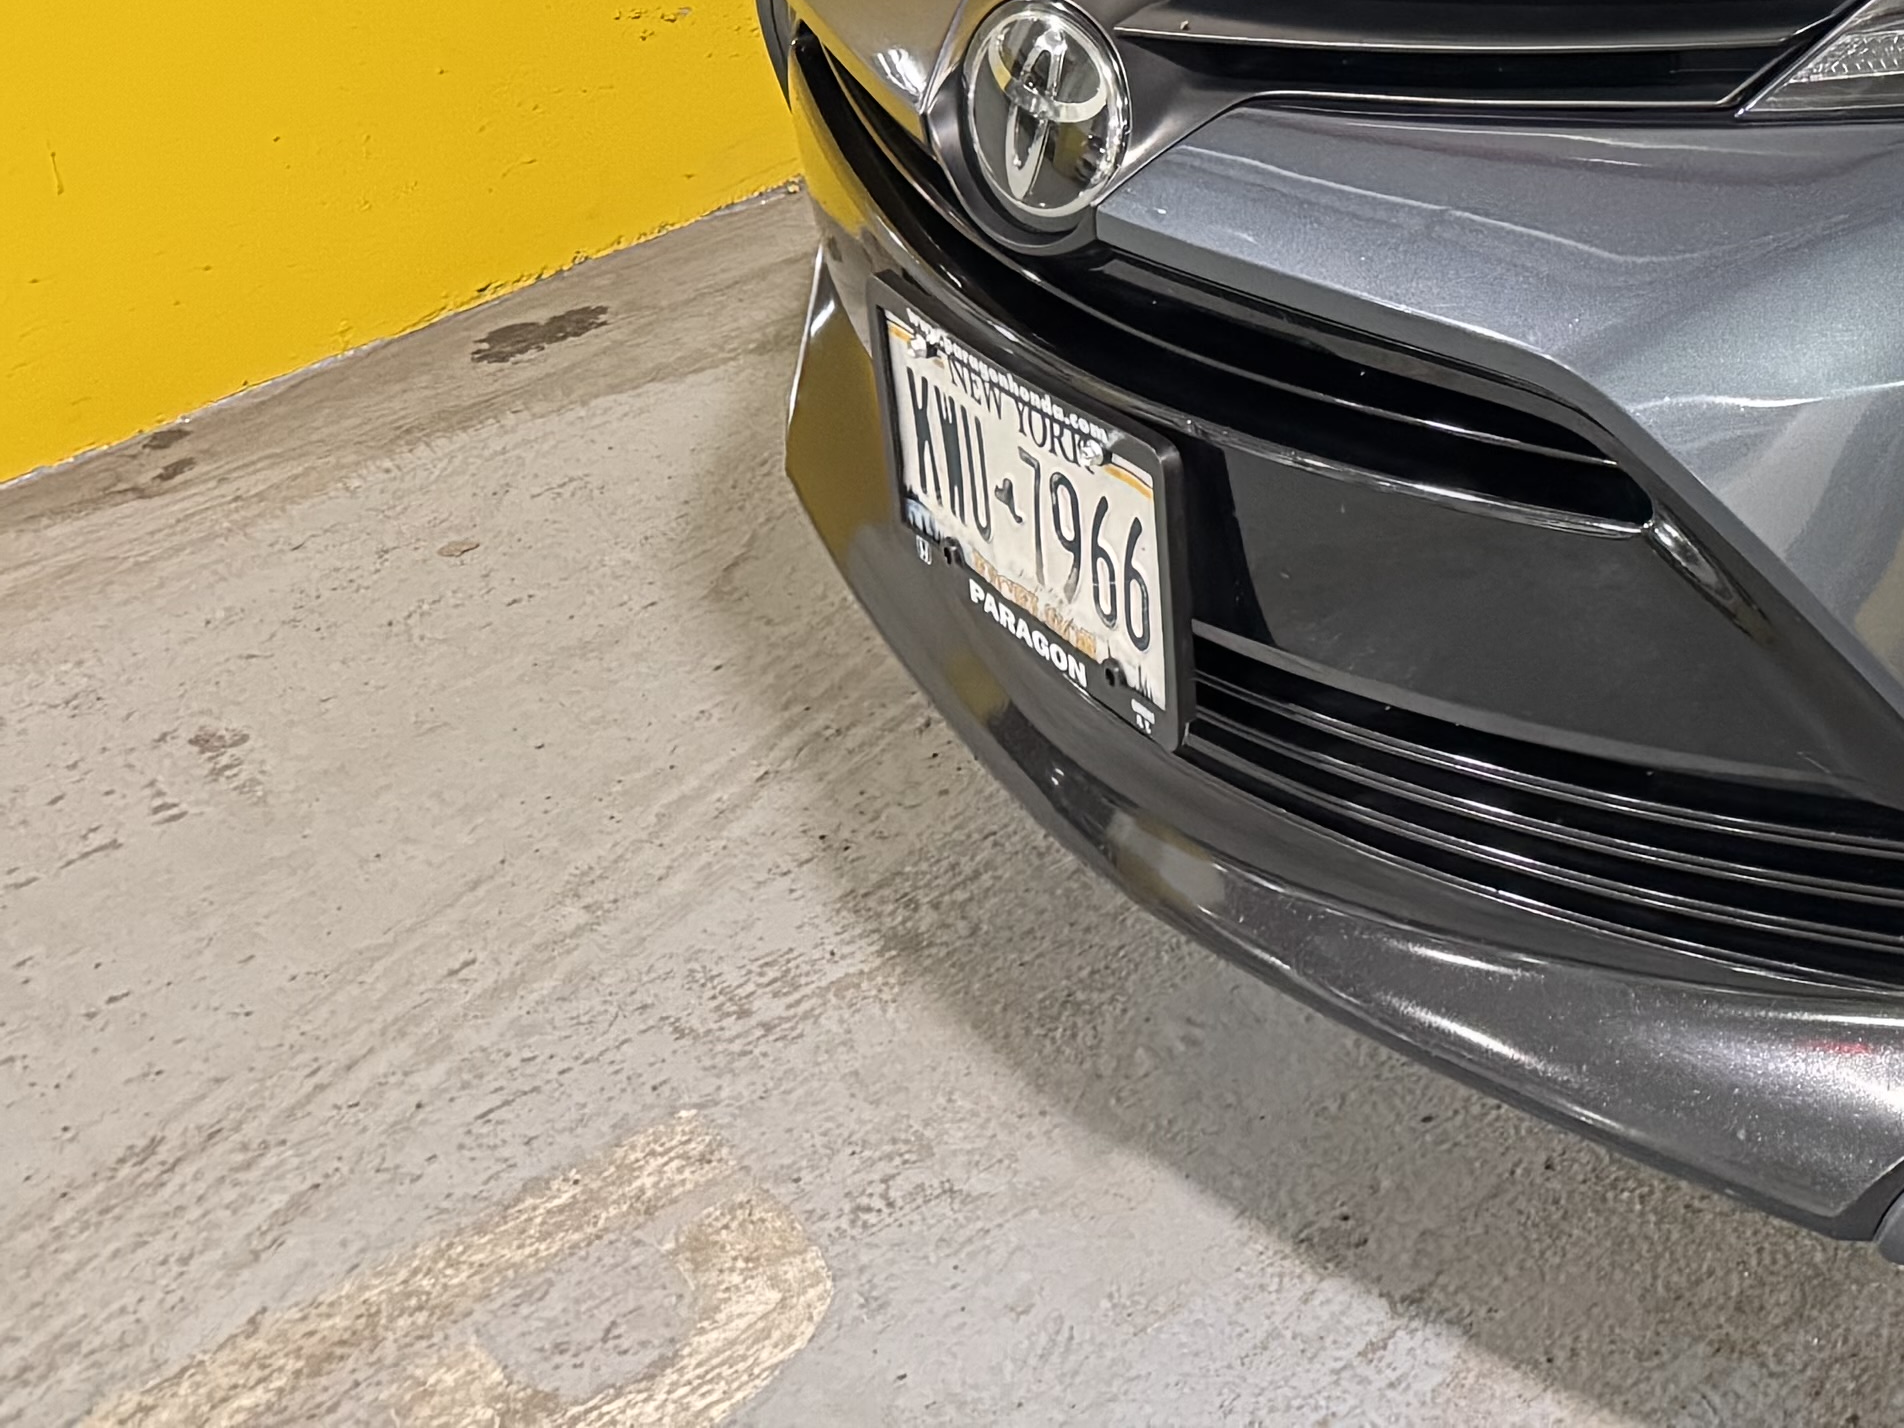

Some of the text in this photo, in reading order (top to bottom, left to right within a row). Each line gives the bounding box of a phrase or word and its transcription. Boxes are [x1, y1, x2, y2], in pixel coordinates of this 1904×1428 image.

[949, 354, 1002, 420] NEW
[1018, 446, 1151, 652] 7966
[968, 578, 1088, 688] PARAGON
